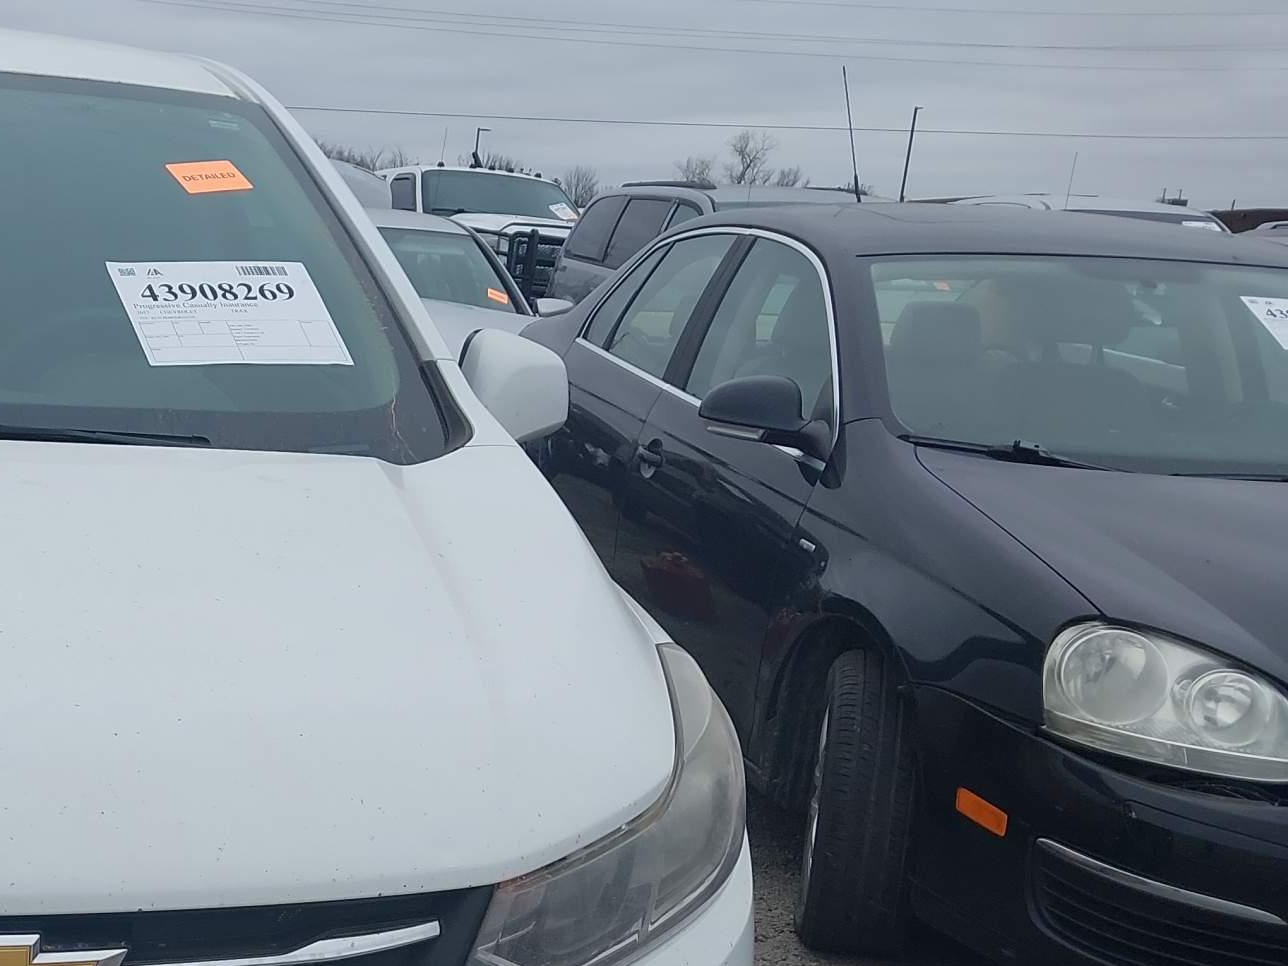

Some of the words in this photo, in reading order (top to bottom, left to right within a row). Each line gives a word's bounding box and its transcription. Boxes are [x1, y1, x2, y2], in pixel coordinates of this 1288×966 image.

[182, 172, 236, 182] DETAILED
[140, 282, 295, 302] 43908269
[182, 302, 218, 310] Casualty
